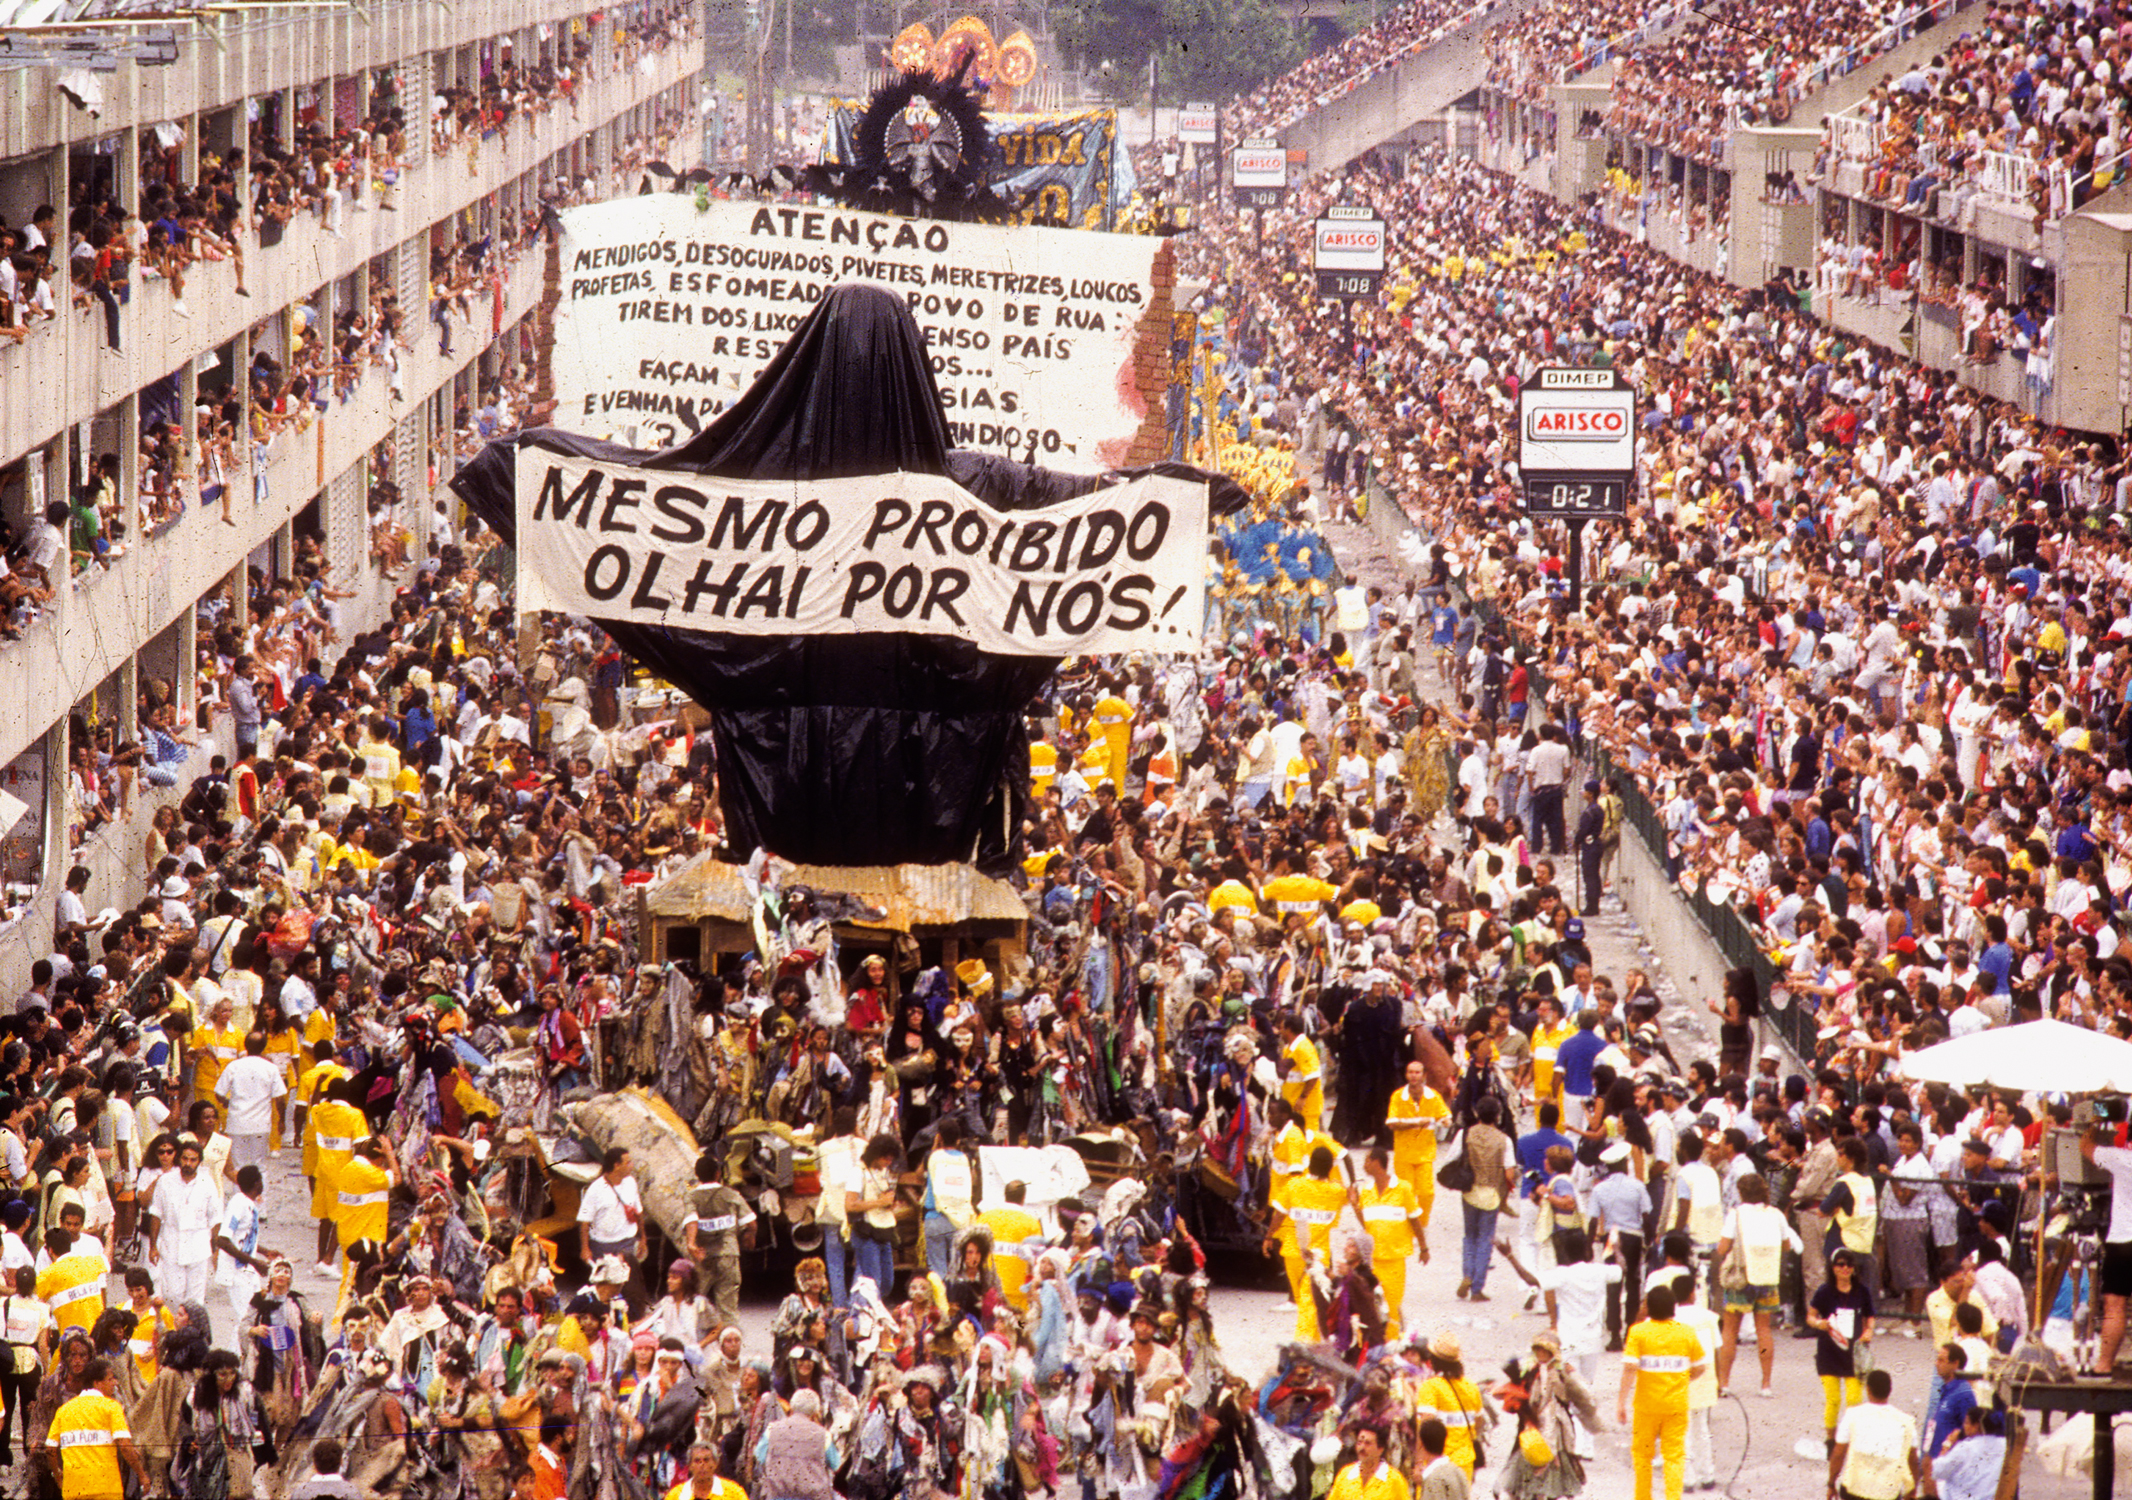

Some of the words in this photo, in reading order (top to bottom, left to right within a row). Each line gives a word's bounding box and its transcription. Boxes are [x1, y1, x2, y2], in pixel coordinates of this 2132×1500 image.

[1241, 158, 1281, 168] ARISCO
[1331, 209, 1370, 217] DIMEP
[1325, 233, 1378, 246] ARISCO
[573, 240, 683, 272] MENDIGOS,
[684, 240, 840, 283] DESOCUPADOS,
[841, 254, 927, 288] PIVETES,
[930, 263, 1069, 302] MERETRIZES,
[1070, 278, 1147, 310] LOUCOS,
[571, 270, 657, 301] PROFETAS,
[906, 291, 985, 321] POVO
[1003, 302, 1042, 327] DE
[617, 299, 693, 325] TIREM
[701, 306, 749, 329] DOS
[1002, 332, 1073, 361] PAÍS
[638, 358, 719, 386] FAÇAM
[938, 386, 1019, 414] SIAS
[1547, 373, 1608, 384] DIMEP
[1537, 412, 1623, 431] ARISCO
[1551, 484, 1611, 508] 0:21
[533, 466, 832, 552] MESMO
[863, 498, 1171, 573] PROIBIDO
[584, 543, 813, 620] OLHAI
[839, 560, 969, 626] POR
